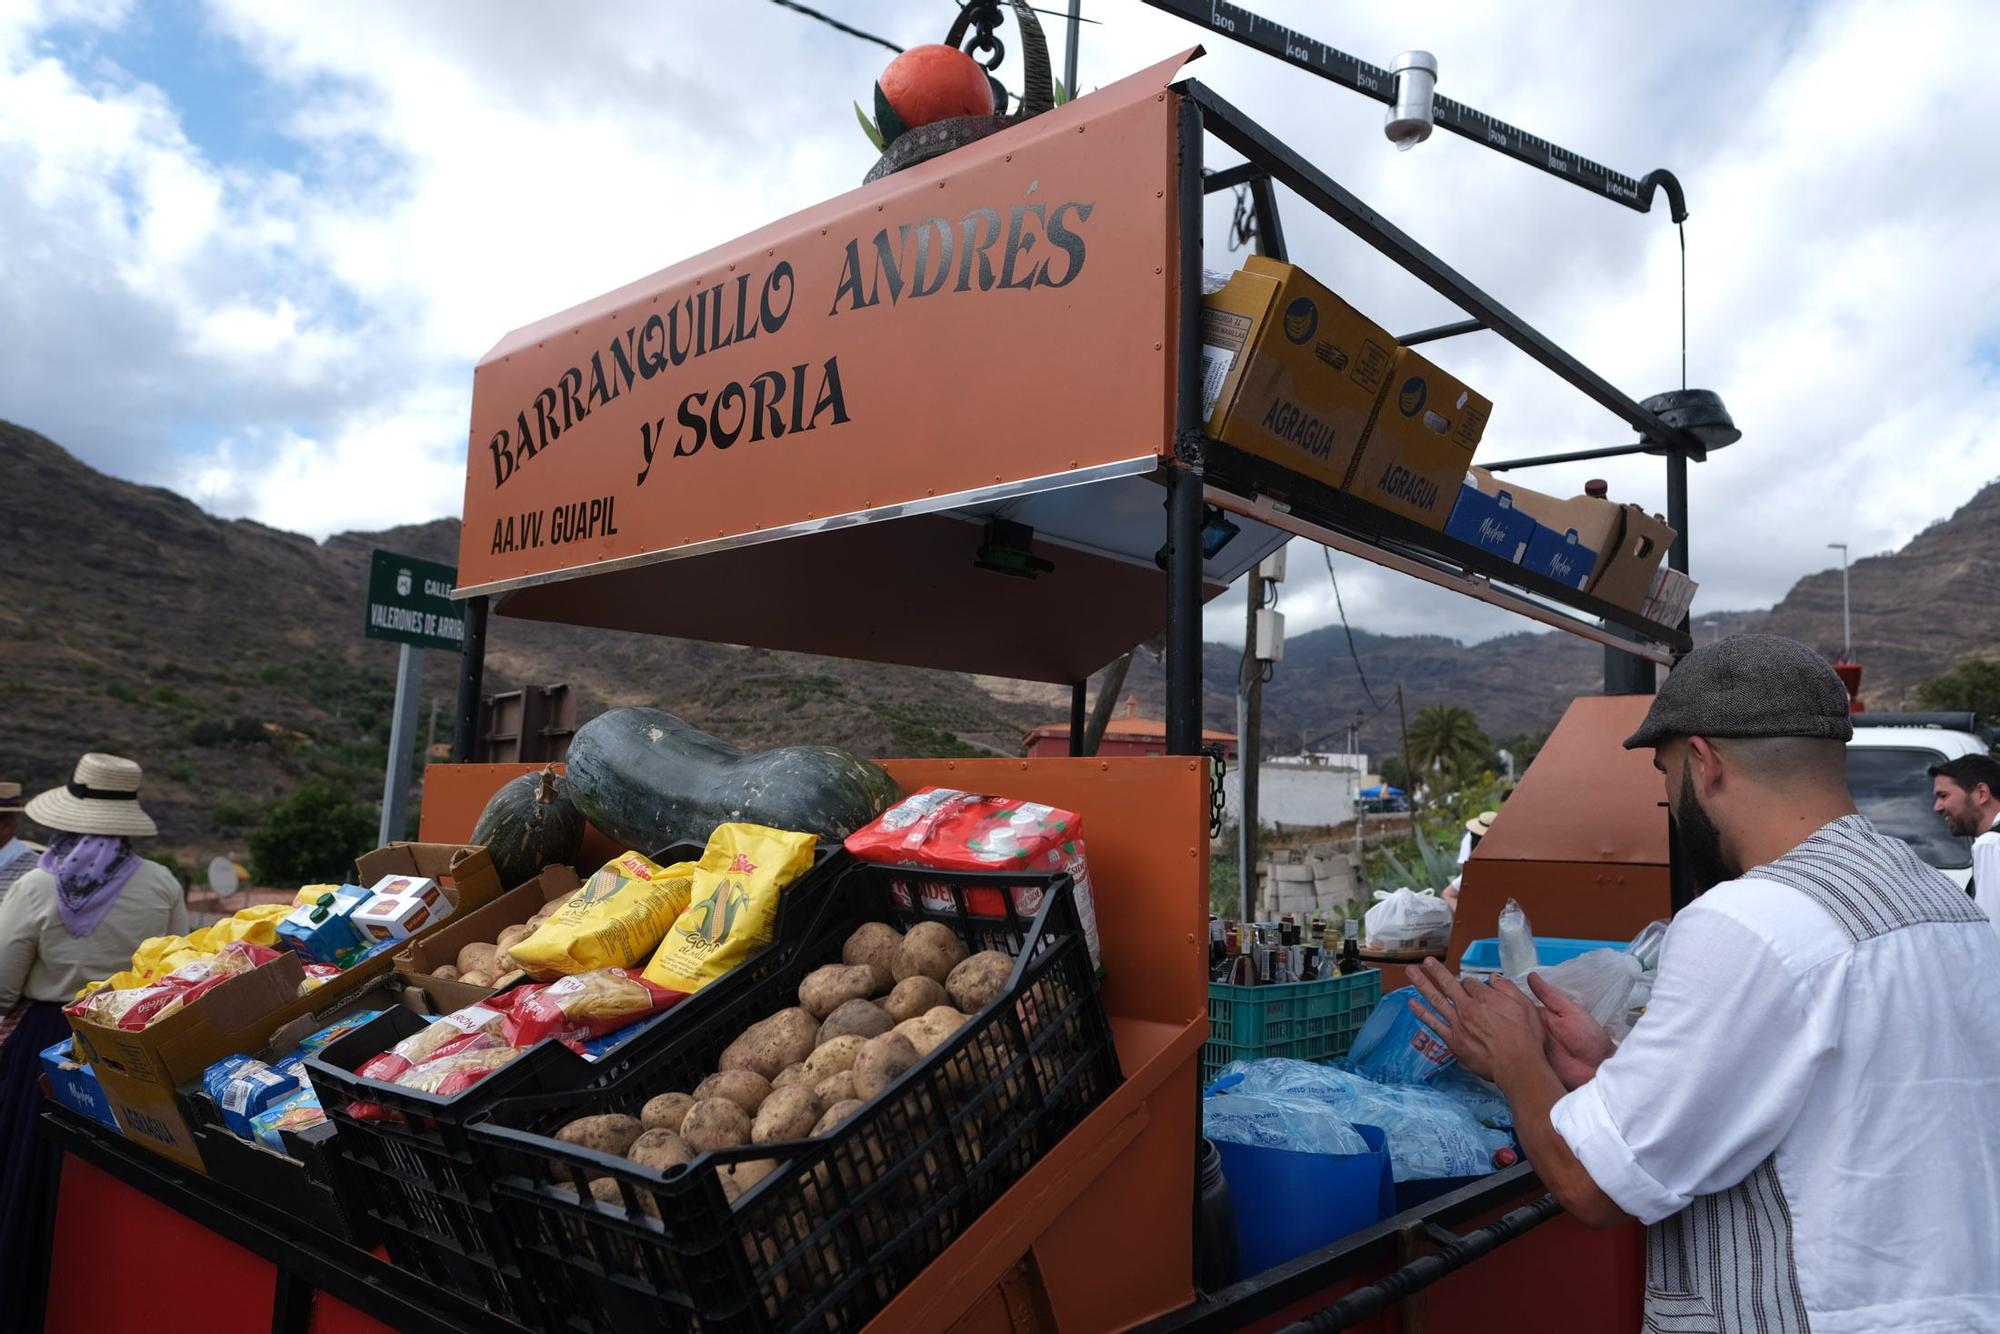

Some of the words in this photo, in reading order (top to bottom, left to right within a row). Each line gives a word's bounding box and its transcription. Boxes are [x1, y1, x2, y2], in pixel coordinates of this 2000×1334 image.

[1214, 12, 1235, 32] 300
[1288, 46, 1309, 62] 400
[1359, 74, 1378, 91] 500
[488, 260, 795, 490] BARRANQUILLO
[828, 180, 1096, 317] ANDRÉS
[635, 416, 664, 487] y
[672, 355, 852, 458] SORIA
[1262, 399, 1336, 461] AGRAGUA
[1377, 462, 1440, 512] AGRAGUA
[491, 509, 544, 556] AA.VV.
[550, 495, 619, 545] GUAPIL
[424, 579, 452, 599] CALLE
[371, 603, 424, 634] VALERONES
[424, 613, 437, 636] DE
[437, 616, 465, 641] ARRIB
